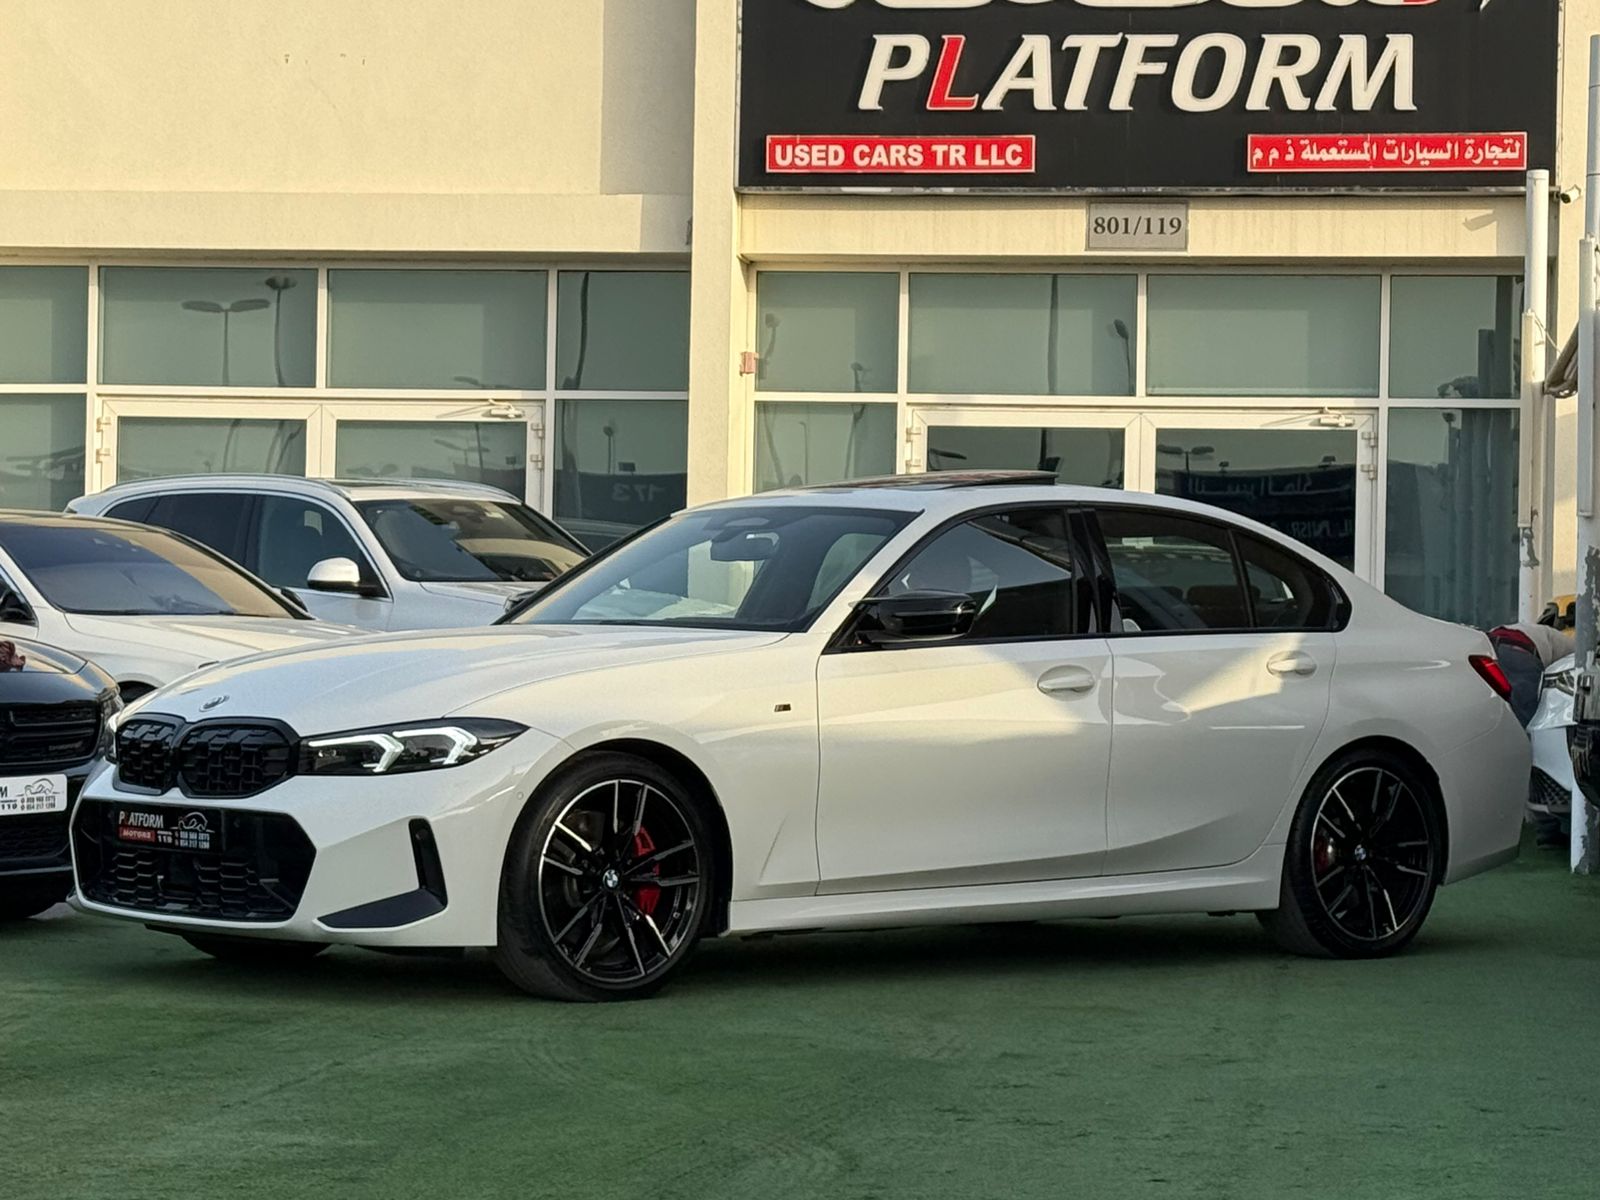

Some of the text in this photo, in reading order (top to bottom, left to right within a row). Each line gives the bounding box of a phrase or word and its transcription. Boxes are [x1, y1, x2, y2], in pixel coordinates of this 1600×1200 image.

[858, 32, 1417, 112] PLATFORM
[775, 144, 1023, 167] USED CARS TR LLC
[1300, 138, 1377, 162] المستعملة
[1381, 139, 1459, 166] السيارات
[1464, 138, 1521, 165] لتجارة
[1093, 216, 1182, 236] 801/119
[119, 811, 164, 829] PLATFORM
